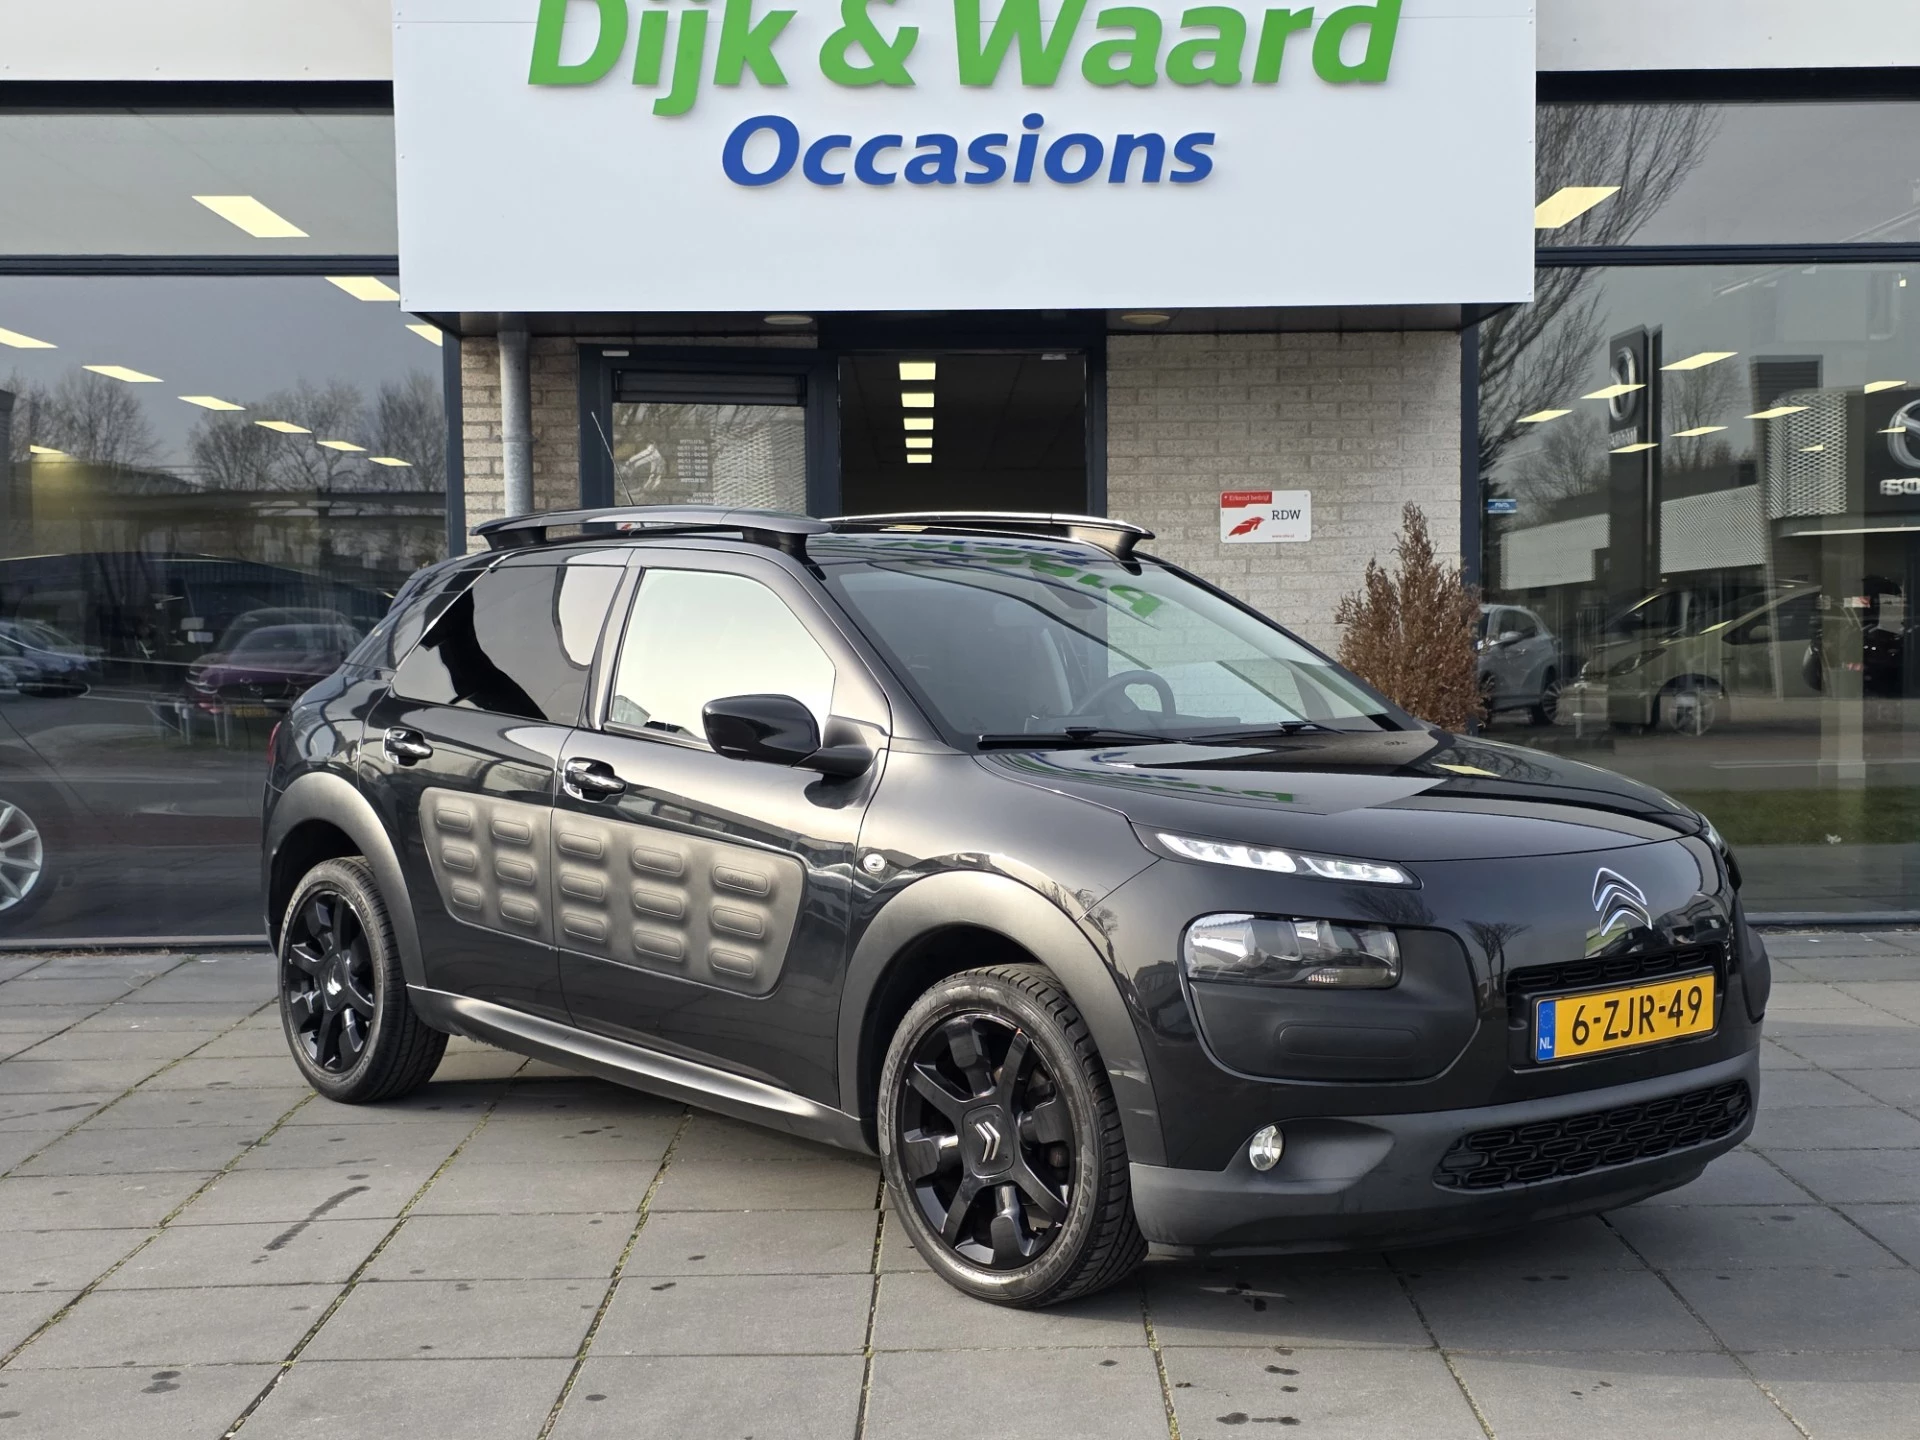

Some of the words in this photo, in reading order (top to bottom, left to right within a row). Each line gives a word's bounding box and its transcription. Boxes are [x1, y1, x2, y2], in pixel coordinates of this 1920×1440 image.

[528, 0, 797, 116] Dijk
[818, 0, 919, 85] &
[955, 0, 1402, 85] Waard
[722, 113, 1216, 186] Occasions
[1271, 509, 1302, 520] RDW
[1539, 1037, 1553, 1050] NL
[1572, 985, 1703, 1046] 6-ZJR-49
